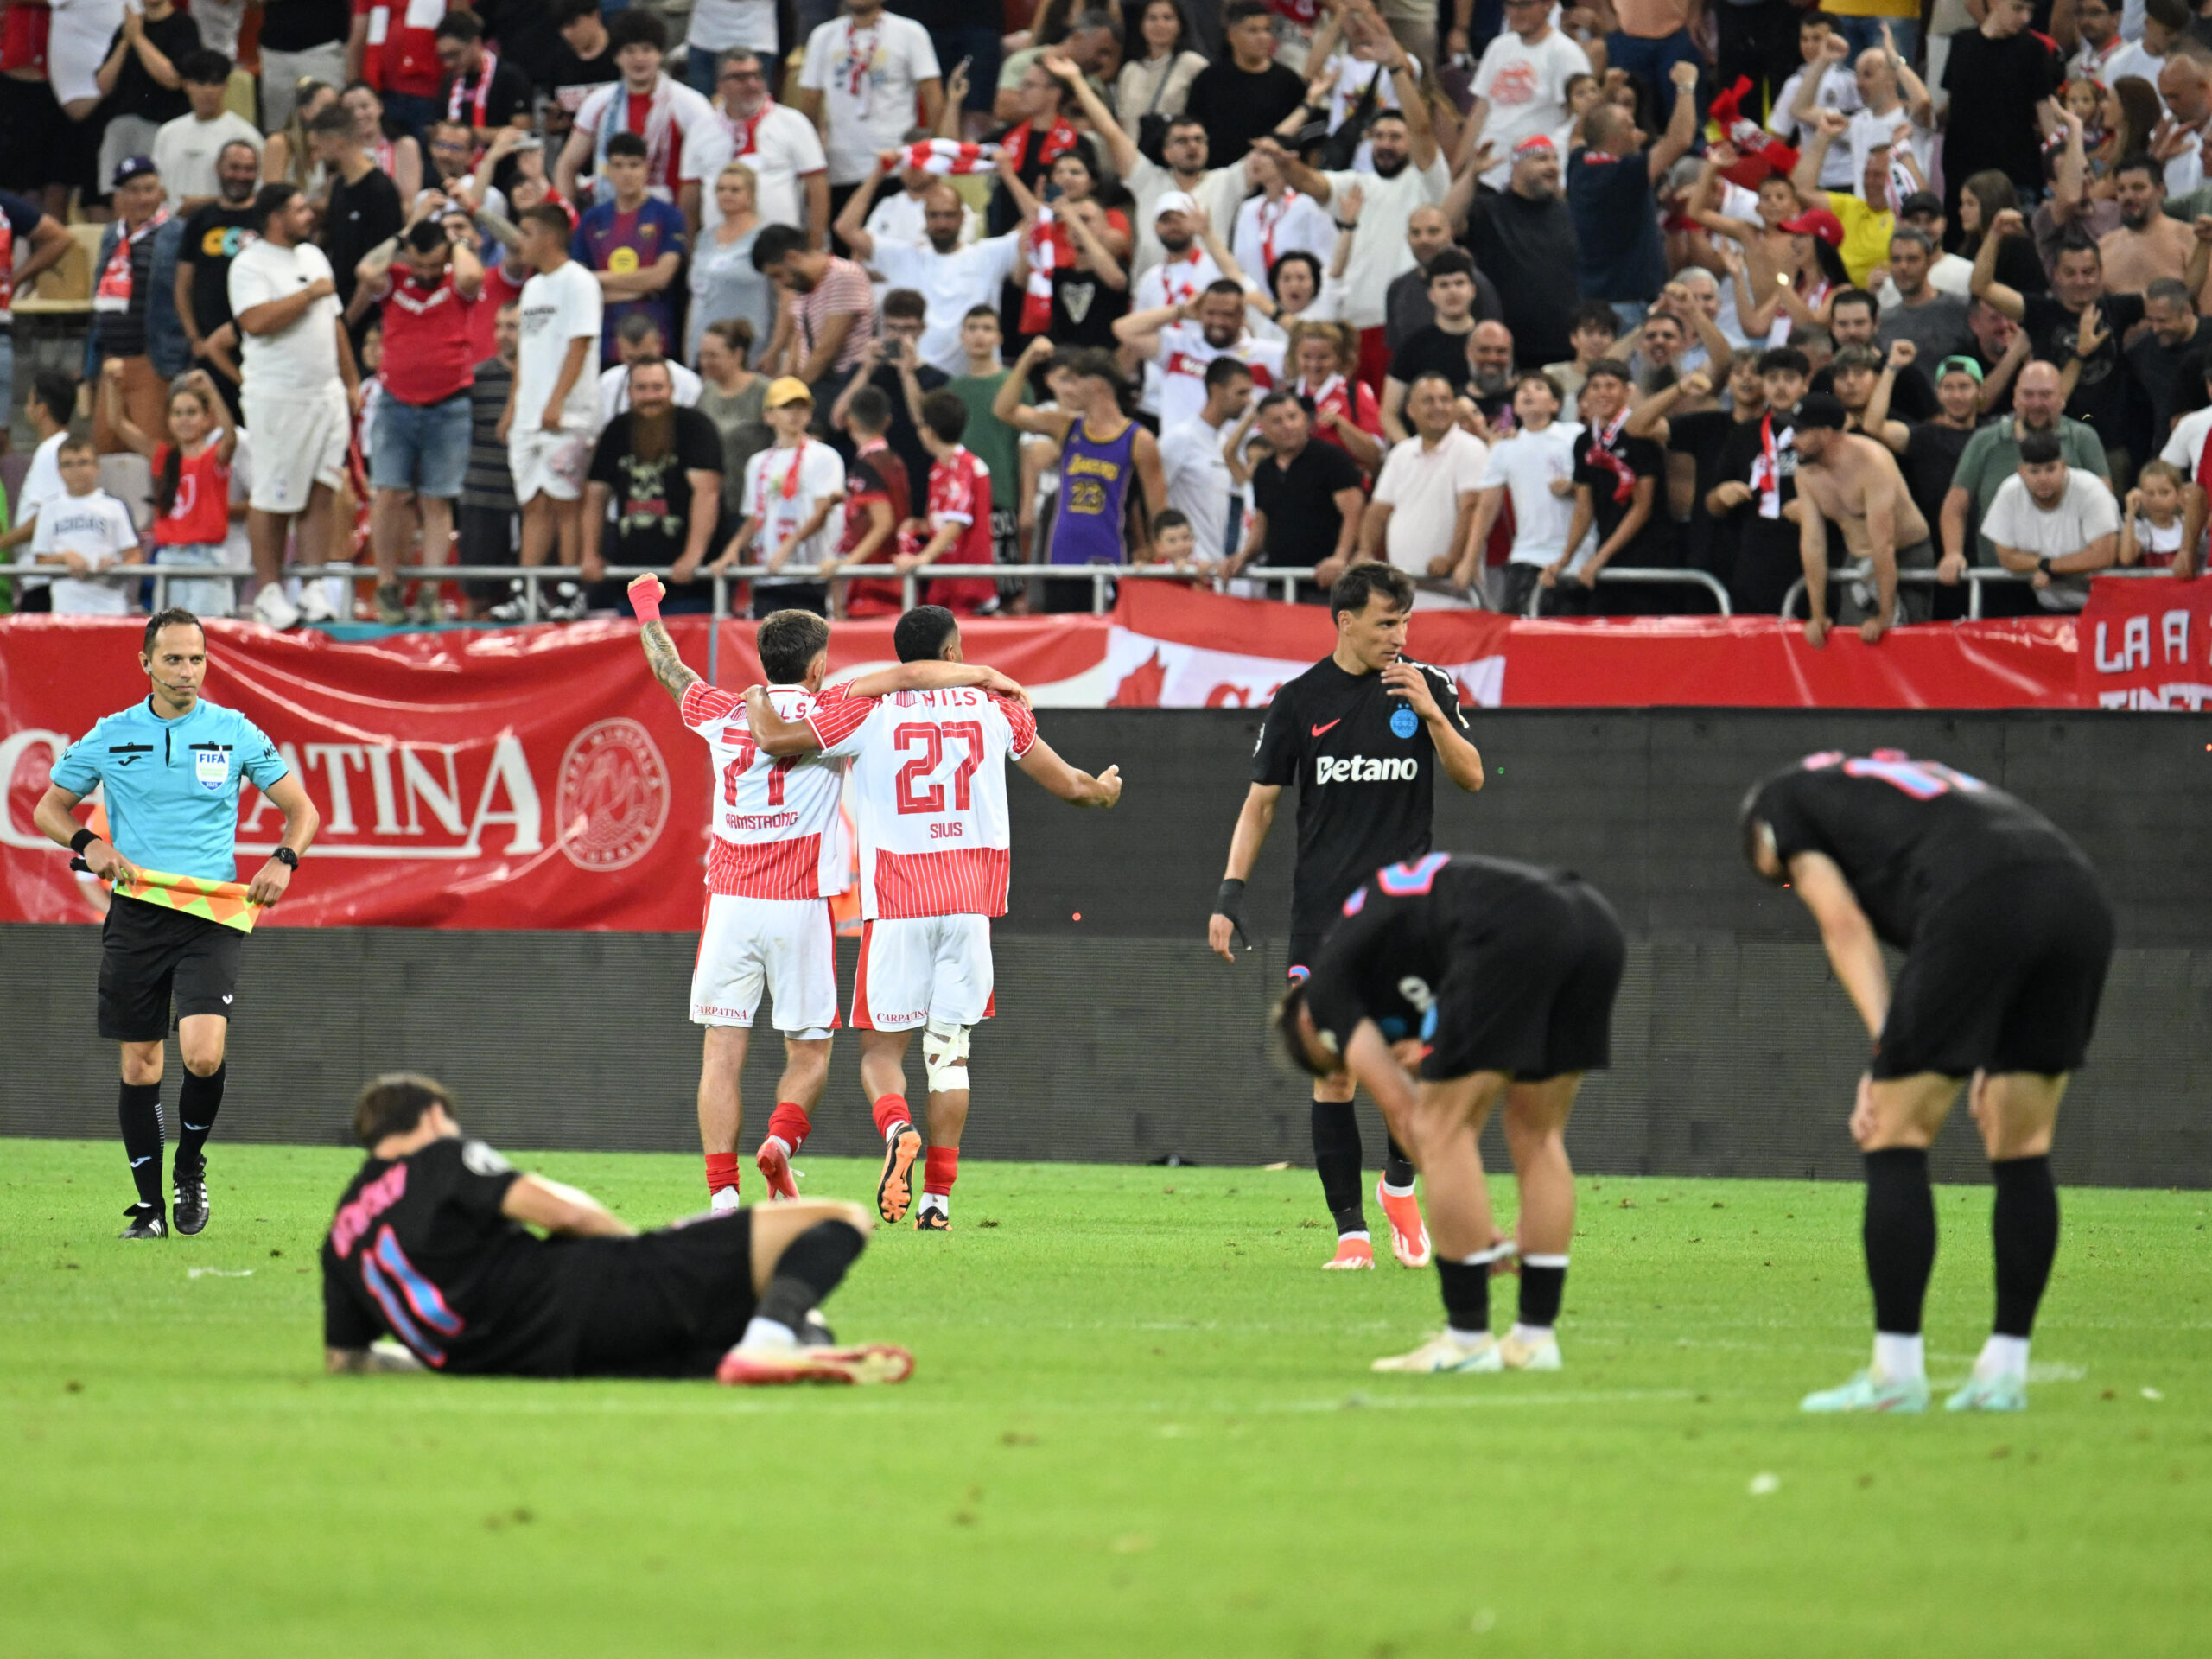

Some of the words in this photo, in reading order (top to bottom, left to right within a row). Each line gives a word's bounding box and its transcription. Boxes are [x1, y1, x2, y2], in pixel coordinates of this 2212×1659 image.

[199, 753, 226, 764] FIFA
[893, 720, 984, 816] 27
[1316, 755, 1418, 785] Betano
[726, 811, 798, 830] ARMSTRONG
